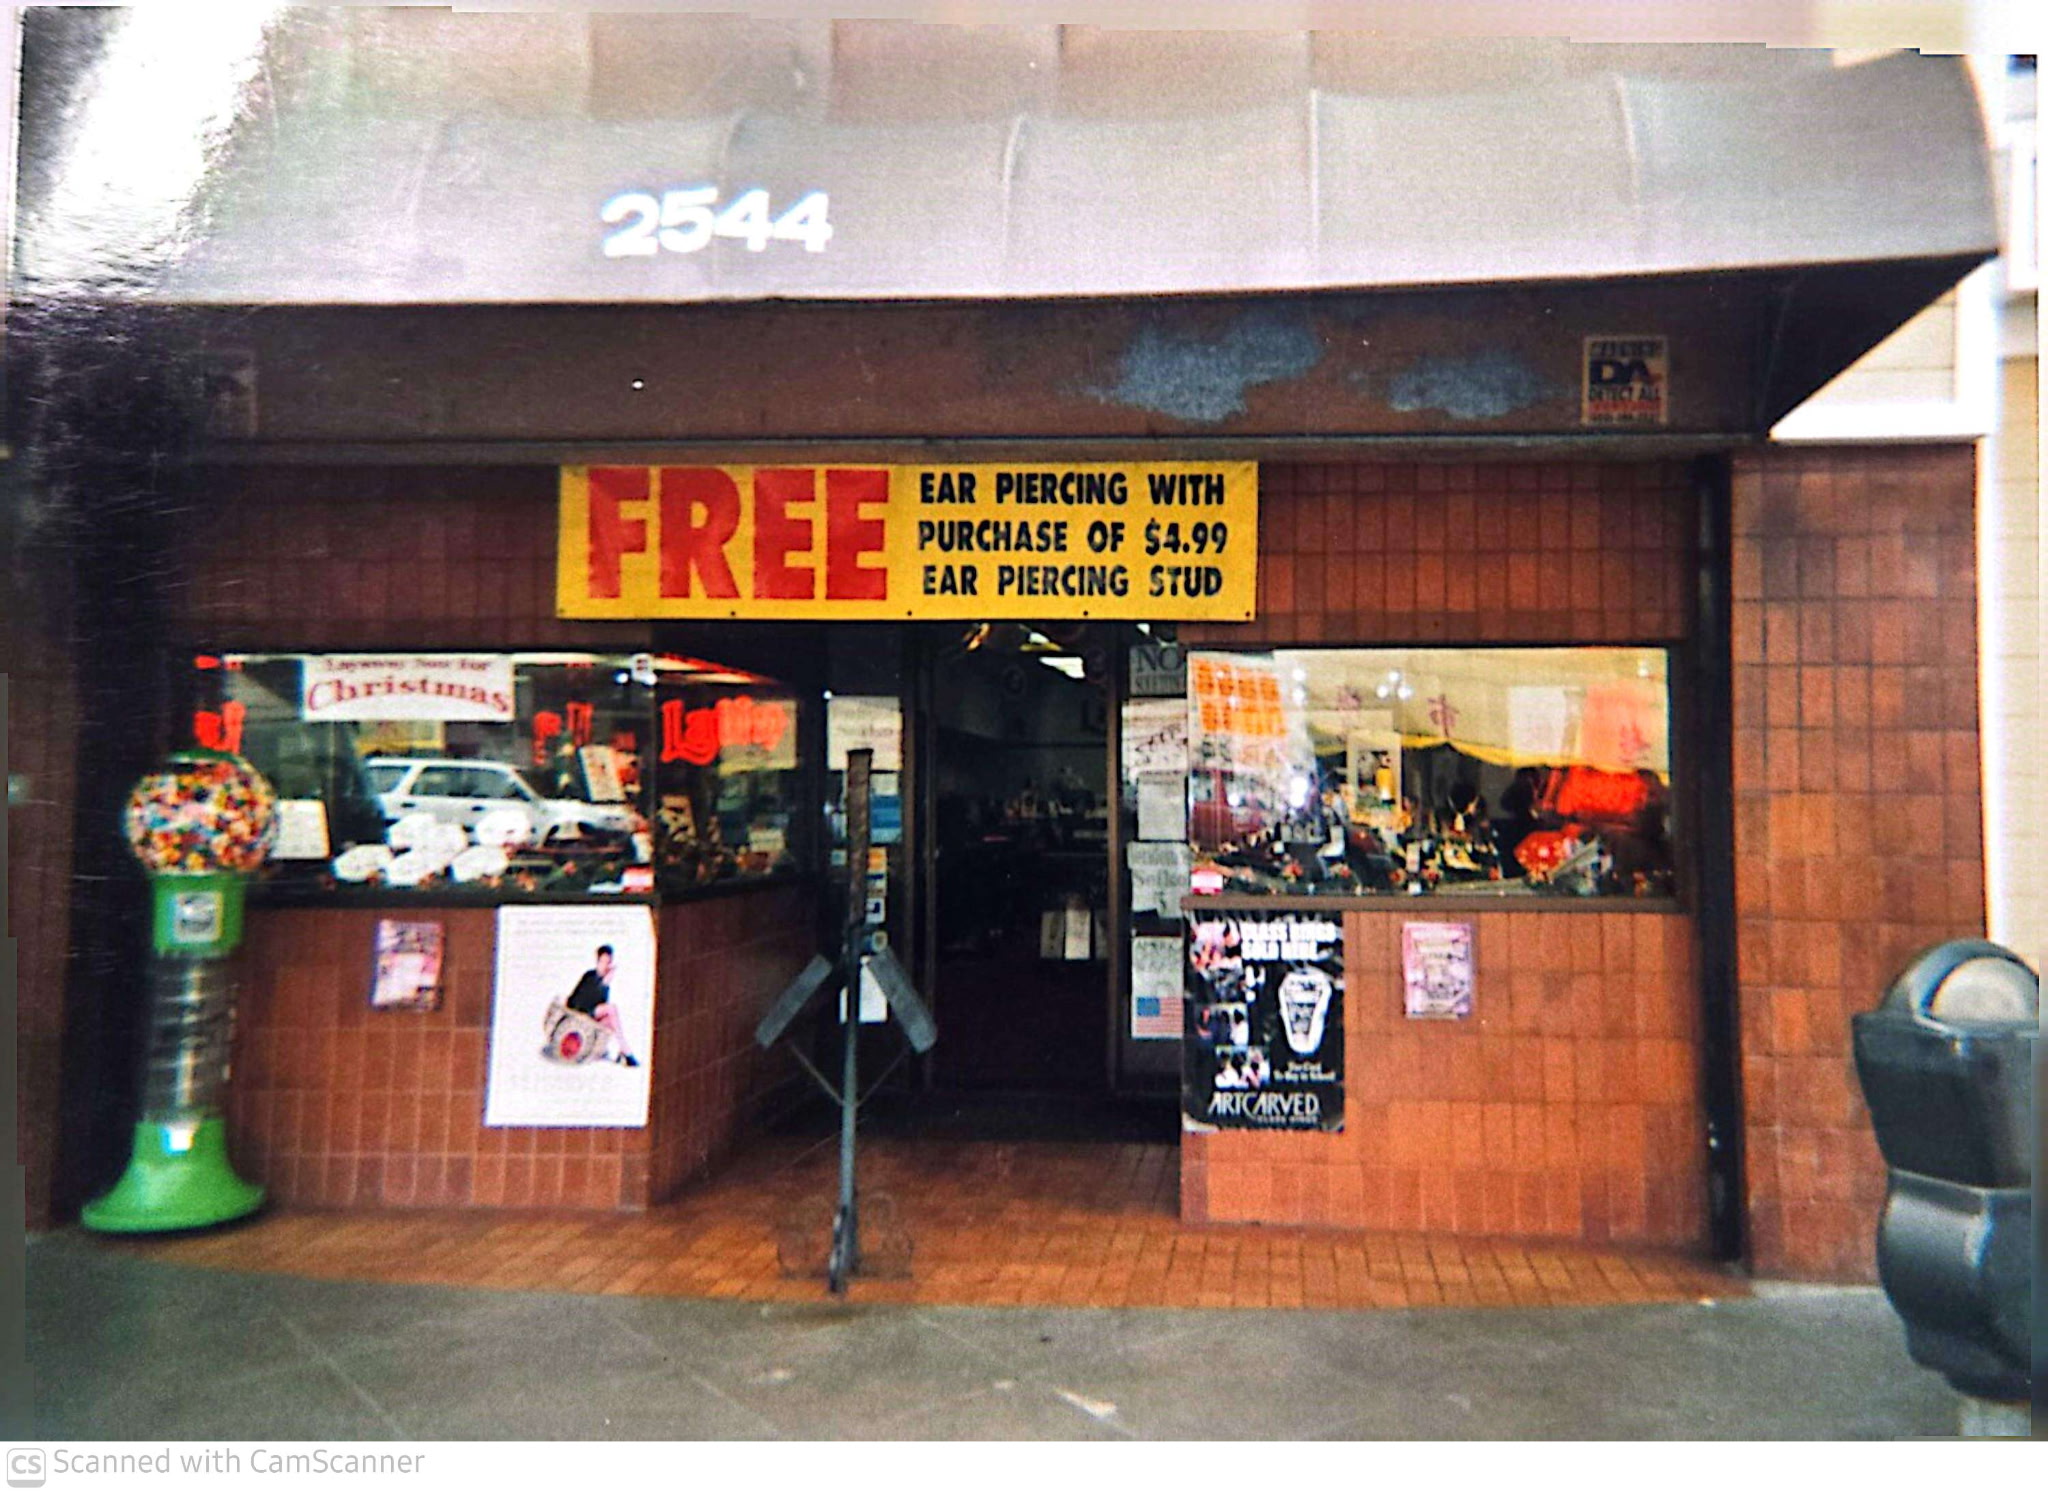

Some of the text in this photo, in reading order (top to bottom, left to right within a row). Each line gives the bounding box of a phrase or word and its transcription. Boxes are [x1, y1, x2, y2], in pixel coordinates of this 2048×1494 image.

[601, 187, 833, 258] 2544
[920, 472, 1225, 506] EAR PIERCING WITH
[586, 467, 891, 601] FREE
[918, 519, 1228, 556] PURCHASE OF $4.99
[923, 565, 1223, 597] EAR PIERCING STUD
[1137, 648, 1182, 671] NO
[308, 675, 508, 712] Christmas
[1207, 1091, 1320, 1119] ARTCARVED
